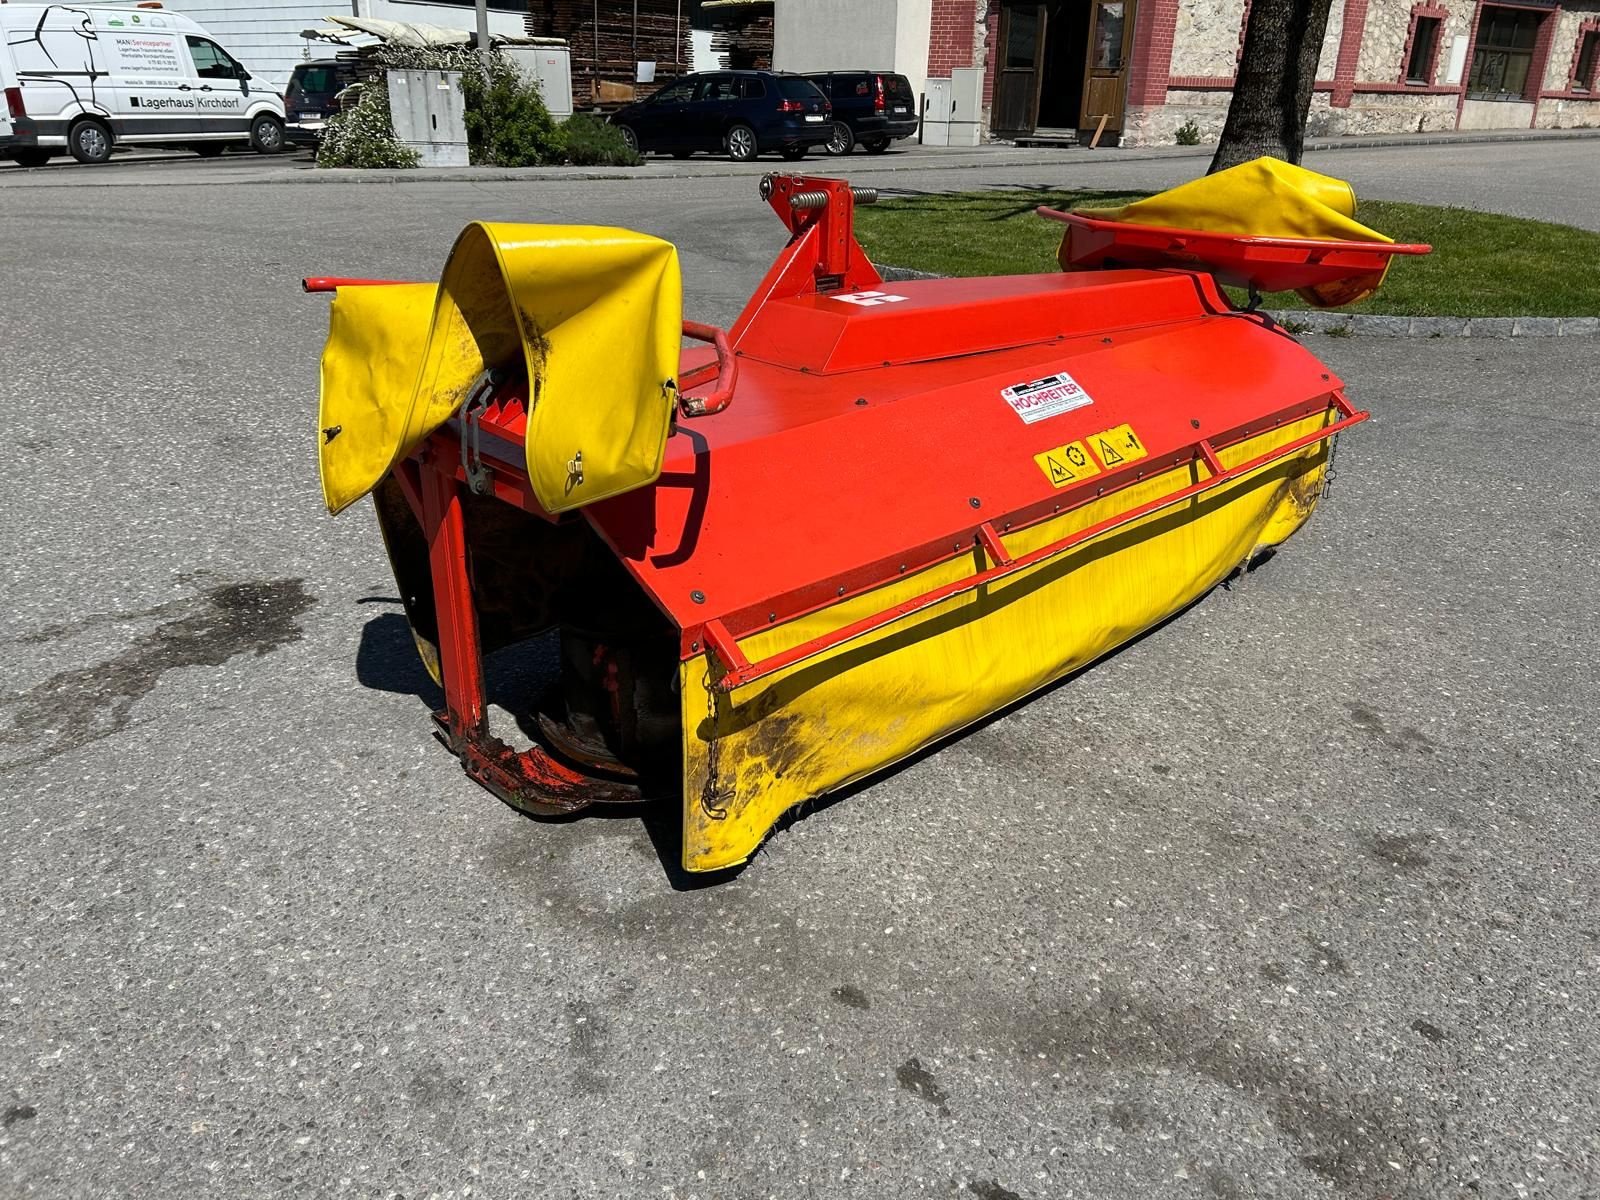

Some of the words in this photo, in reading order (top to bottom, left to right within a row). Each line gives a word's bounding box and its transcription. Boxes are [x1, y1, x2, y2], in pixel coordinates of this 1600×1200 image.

[140, 97, 194, 109] Lagerhaus
[197, 97, 239, 108] Kirchdorf
[1010, 383, 1081, 410] HOCHREITER
